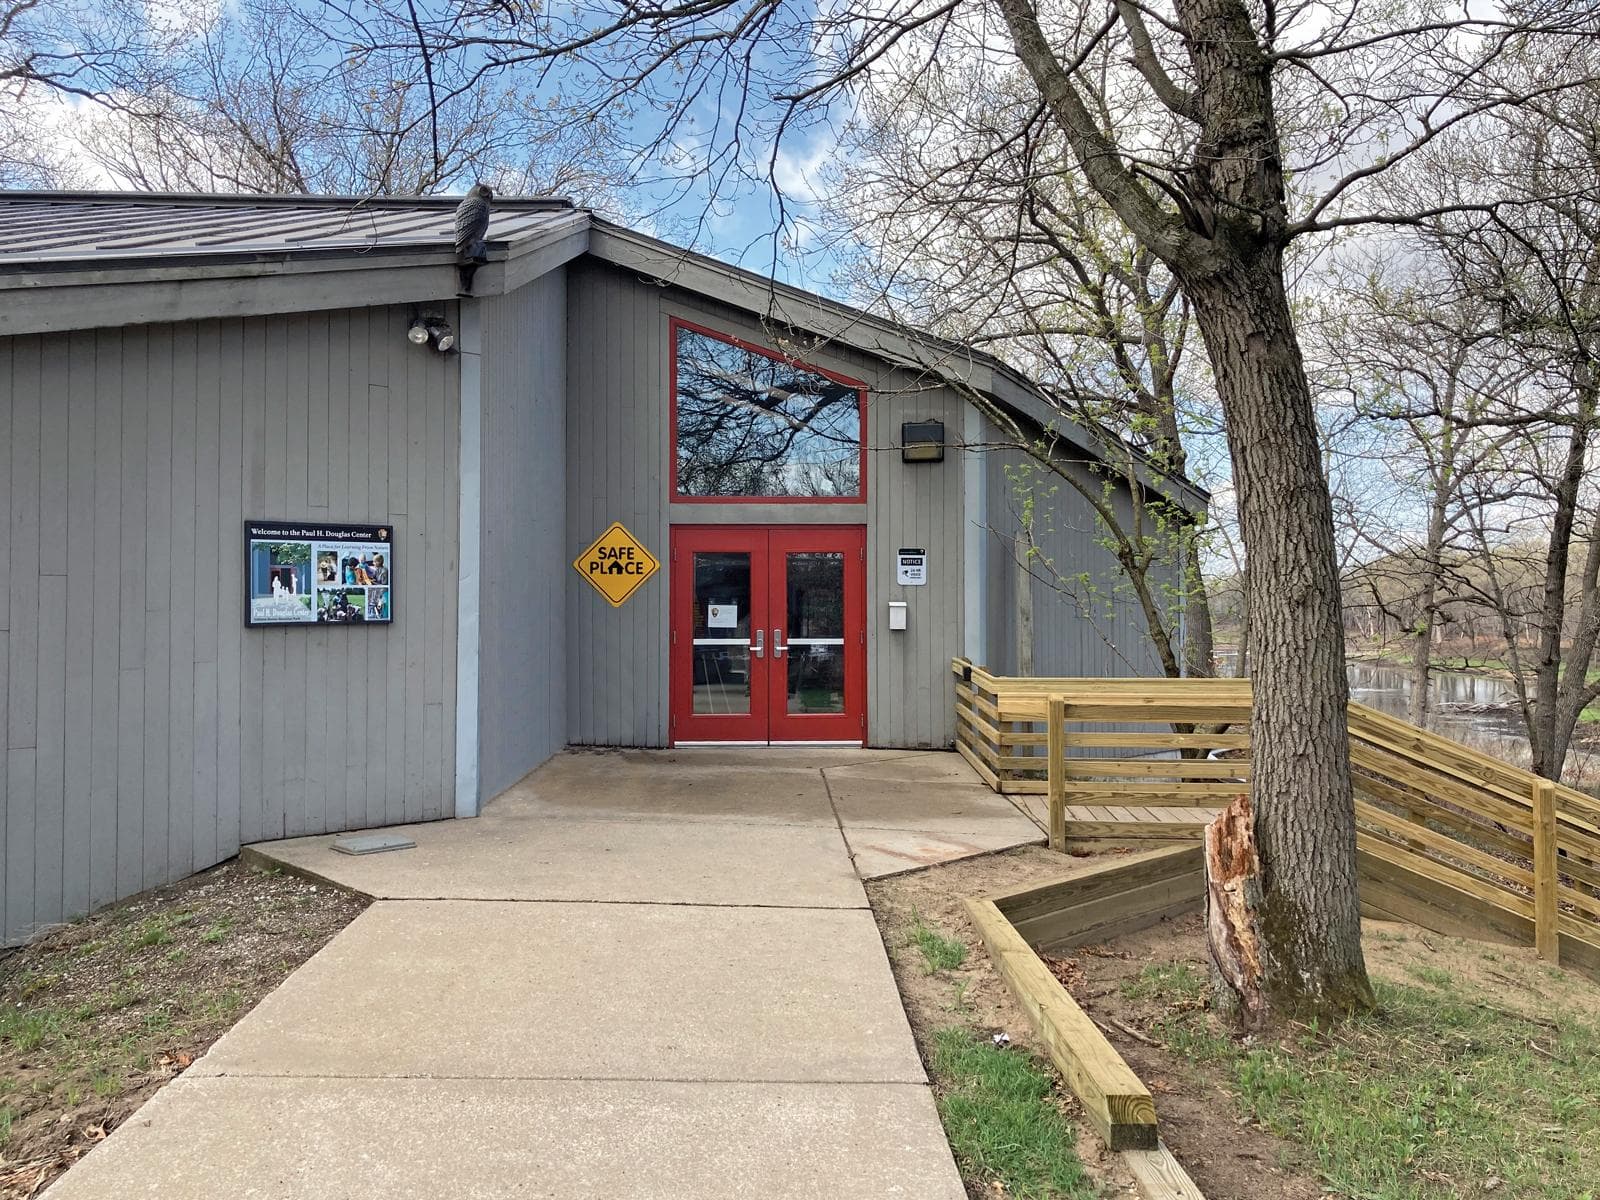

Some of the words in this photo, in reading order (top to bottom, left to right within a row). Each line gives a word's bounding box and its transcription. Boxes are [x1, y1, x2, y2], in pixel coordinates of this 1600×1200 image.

[251, 528, 281, 536] Welcome
[282, 528, 289, 536] to
[290, 528, 300, 536] the
[326, 530, 350, 538] Douglas
[598, 546, 634, 560] SAFE
[590, 560, 644, 575] PLACE
[254, 608, 264, 616] Paul
